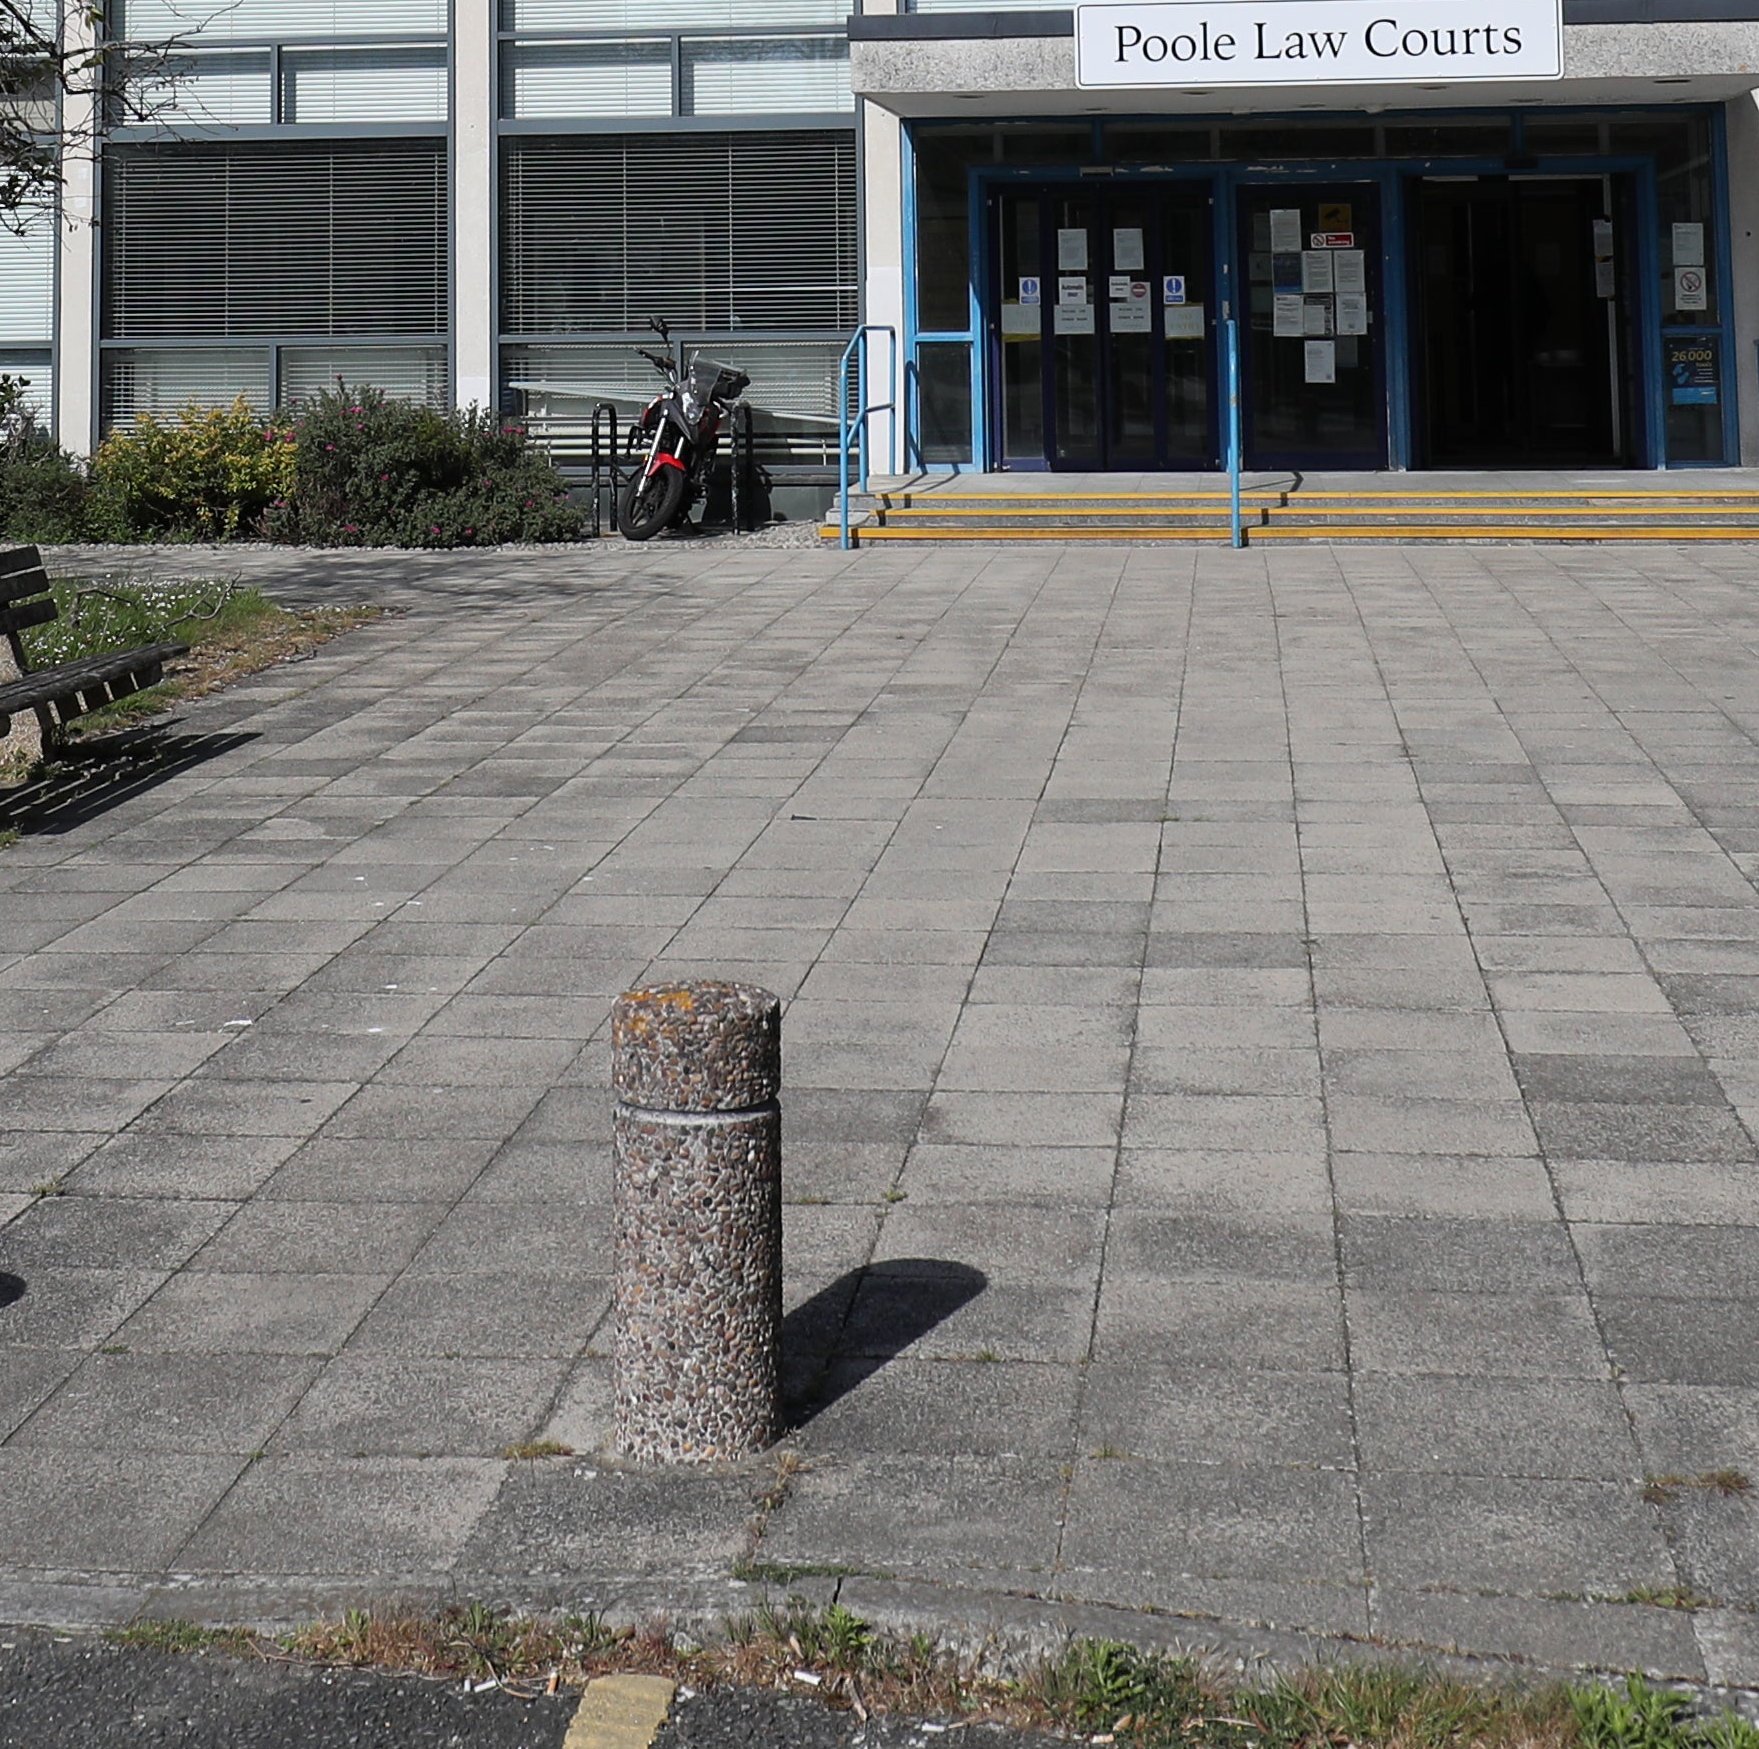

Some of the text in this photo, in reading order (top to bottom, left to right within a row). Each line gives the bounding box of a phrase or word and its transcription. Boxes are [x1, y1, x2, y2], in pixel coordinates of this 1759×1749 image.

[1114, 18, 1523, 63] Poole Law Courts
